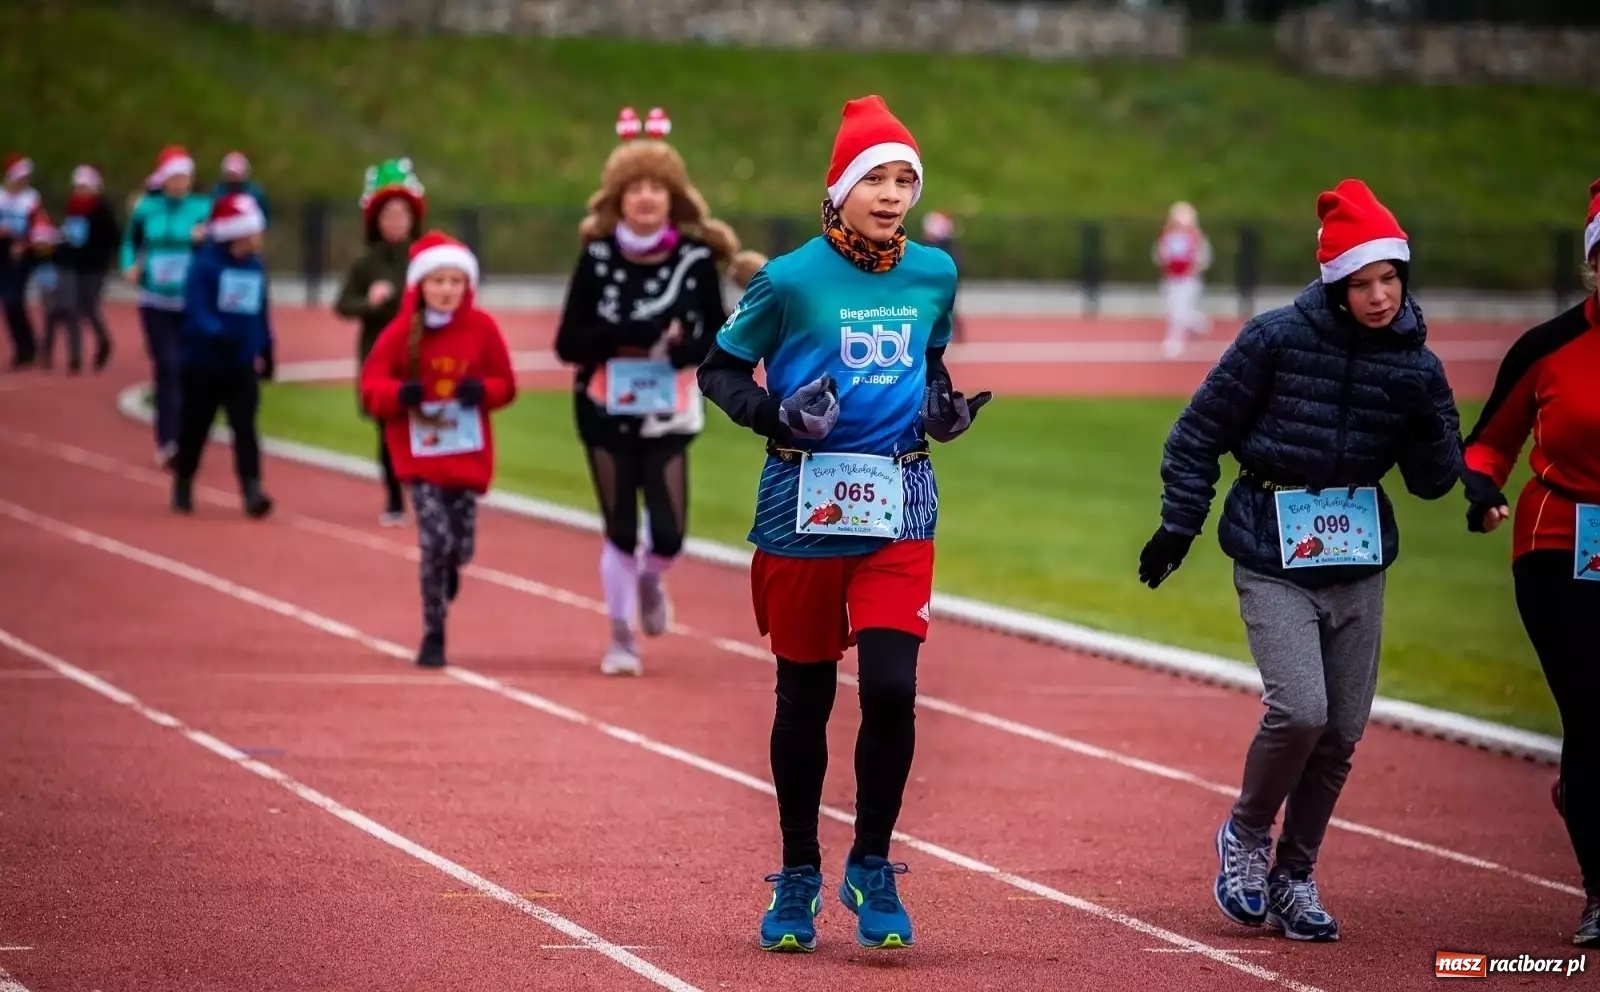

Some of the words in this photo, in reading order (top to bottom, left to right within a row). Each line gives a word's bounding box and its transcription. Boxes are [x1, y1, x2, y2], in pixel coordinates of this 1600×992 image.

[840, 306, 918, 320] BiegamBoLubię
[840, 323, 914, 368] bbl
[834, 481, 875, 503] 065
[1313, 514, 1350, 534] 099
